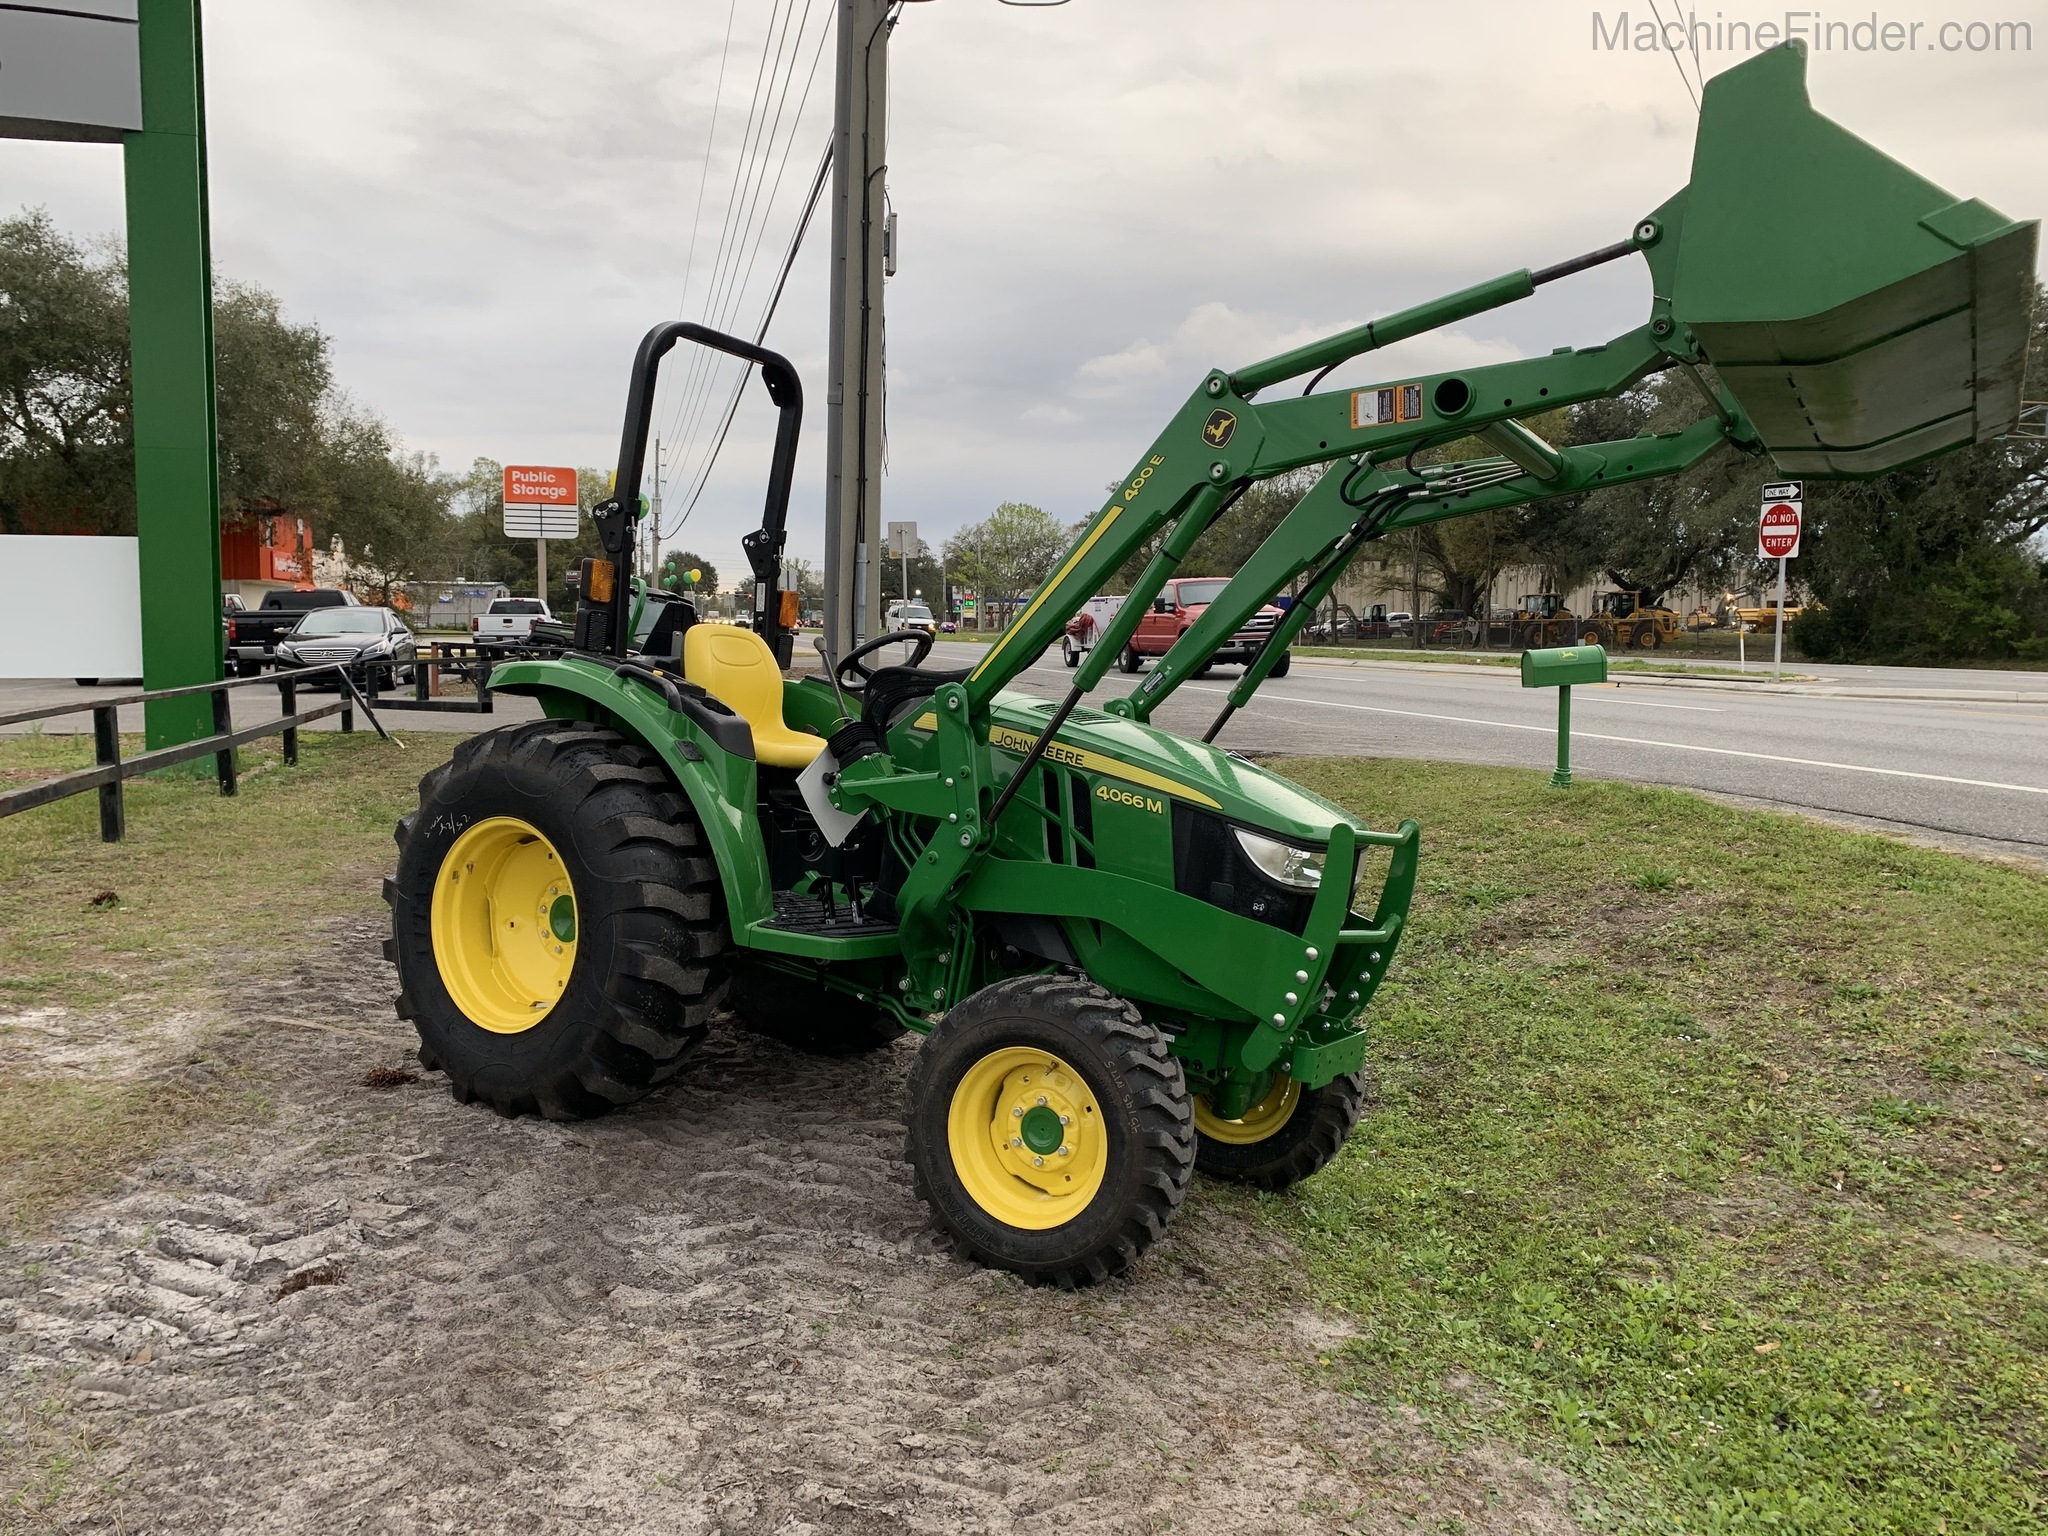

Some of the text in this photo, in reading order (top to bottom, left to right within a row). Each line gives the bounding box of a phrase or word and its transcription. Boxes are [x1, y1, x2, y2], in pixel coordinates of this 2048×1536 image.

[511, 470, 556, 483] Public
[1124, 466, 1154, 501] 400
[512, 483, 567, 500] Storage
[1766, 488, 1790, 497] ONE WAY
[1766, 513, 1796, 524] DO NOT
[1766, 537, 1793, 547] ENTER
[995, 731, 1085, 766] JOHN EERE
[1096, 785, 1162, 814] 4066 M
[934, 1180, 994, 1248] TITAN
